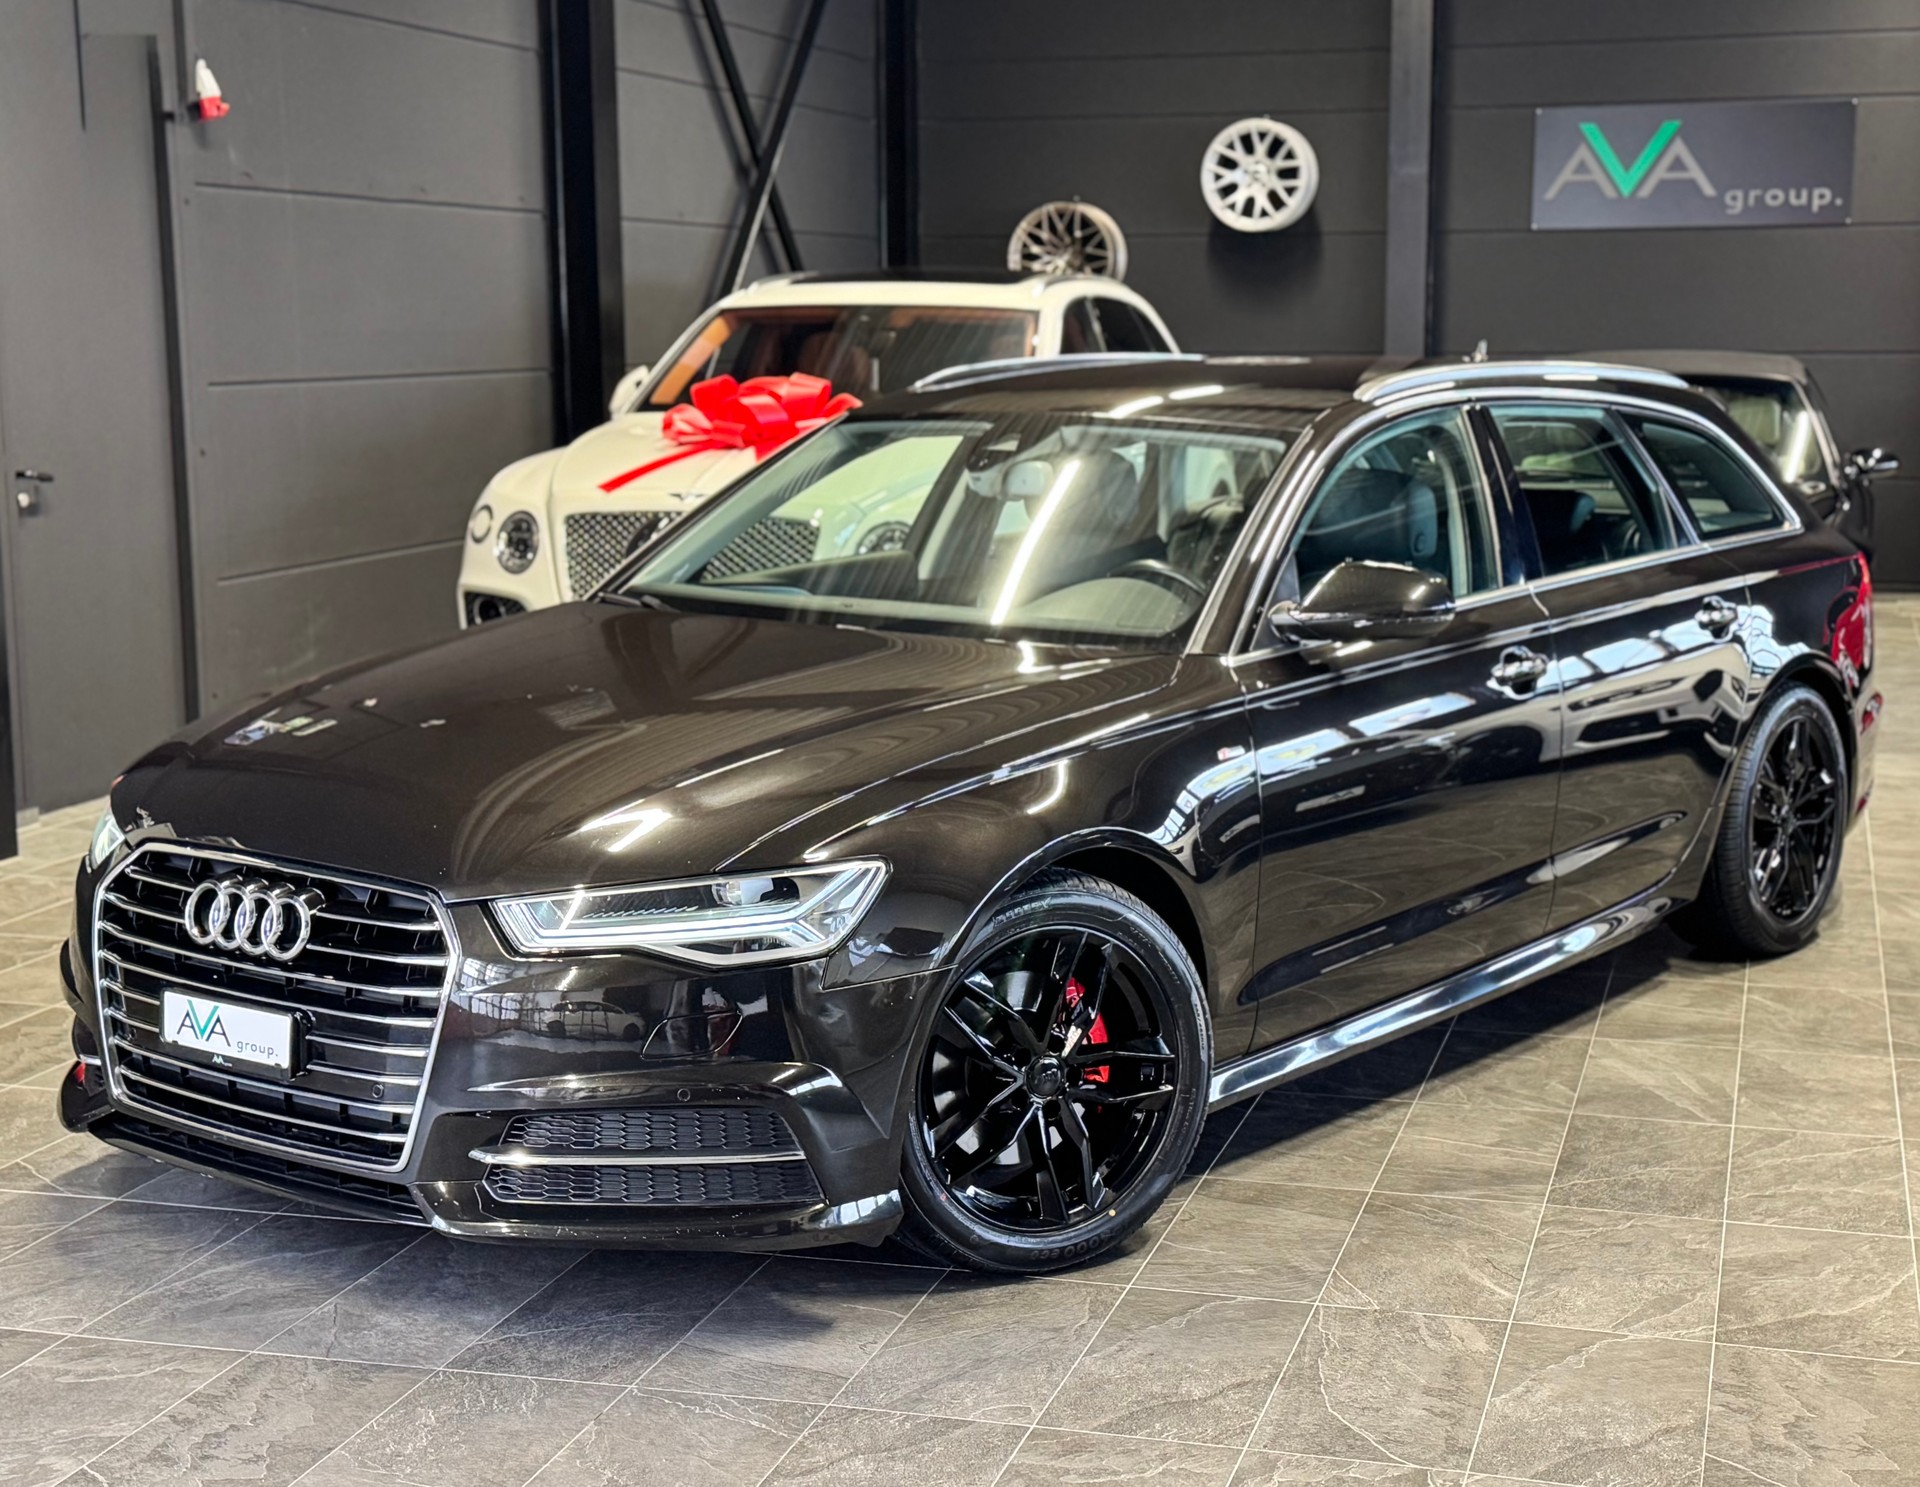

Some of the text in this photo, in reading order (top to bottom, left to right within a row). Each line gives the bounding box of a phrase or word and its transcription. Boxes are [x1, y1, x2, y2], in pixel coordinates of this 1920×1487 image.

[1544, 119, 1844, 215] AVA group.
[176, 999, 279, 1059] AVA group.
